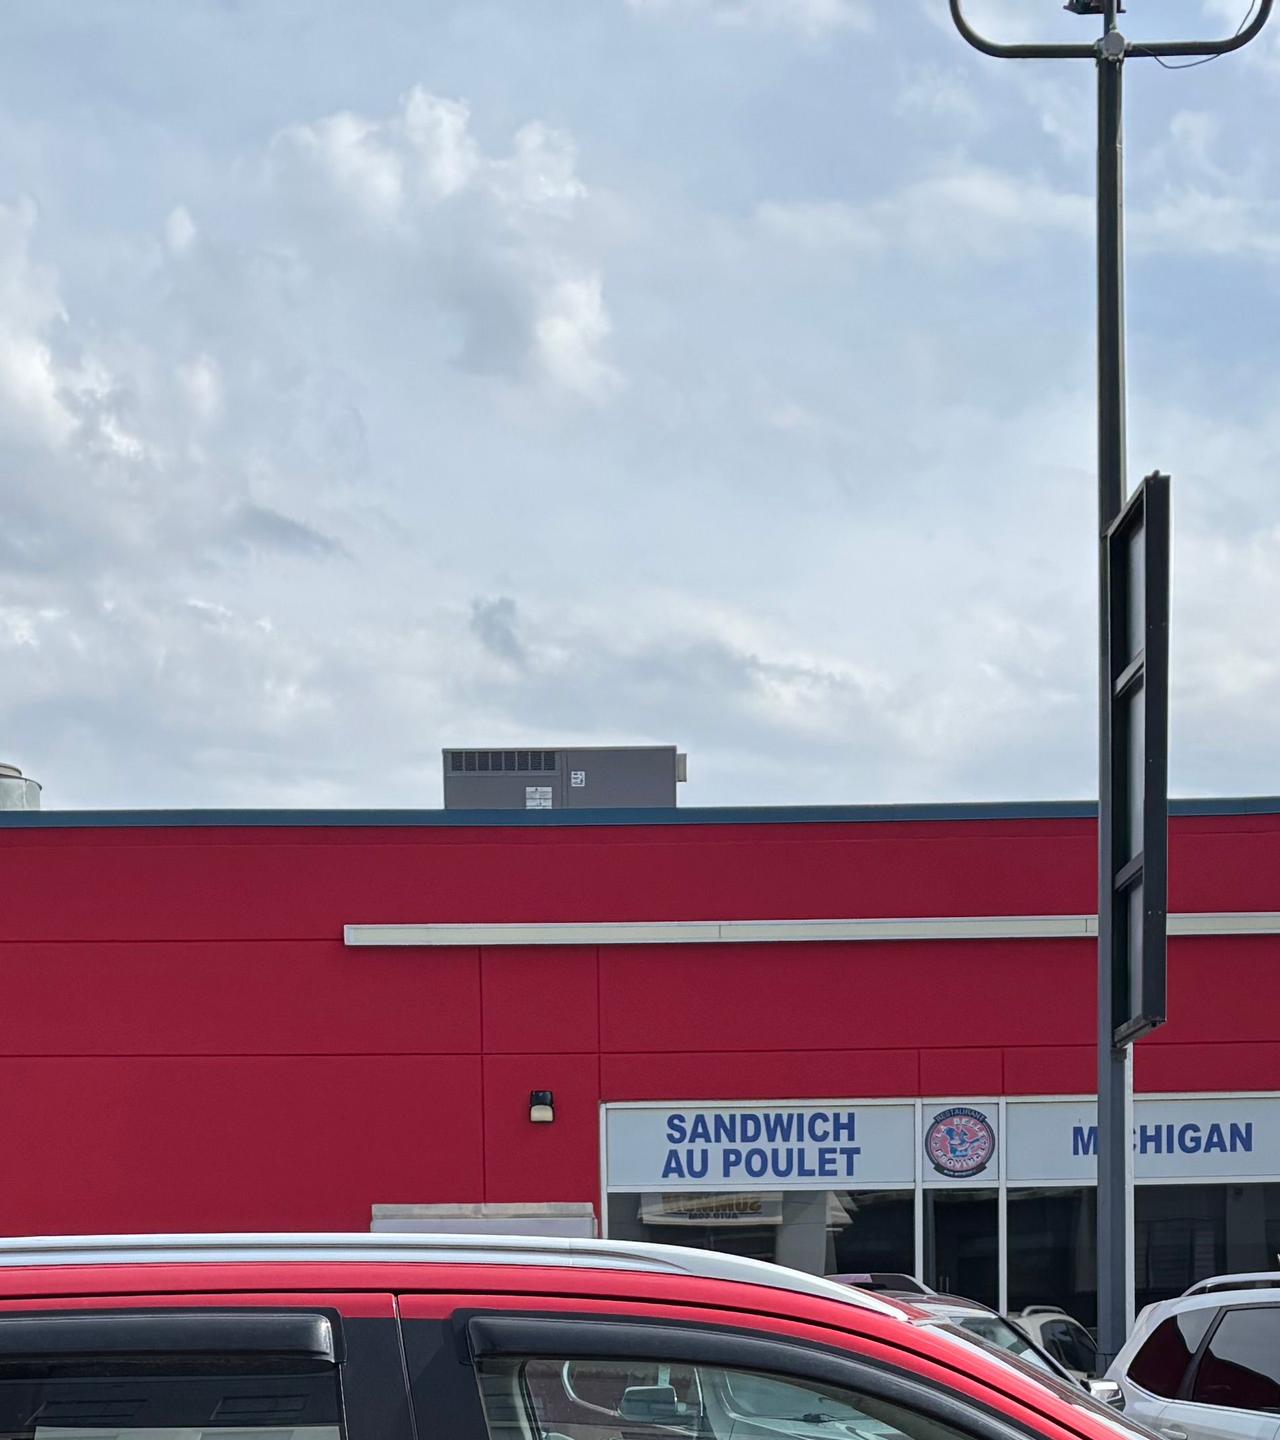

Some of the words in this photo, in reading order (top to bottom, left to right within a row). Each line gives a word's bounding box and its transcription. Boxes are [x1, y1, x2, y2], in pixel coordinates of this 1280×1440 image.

[666, 1112, 856, 1144] SANDWICH
[1073, 1123, 1253, 1155] MHIGAN
[661, 1149, 709, 1178] AU
[722, 1147, 861, 1178] POULET
